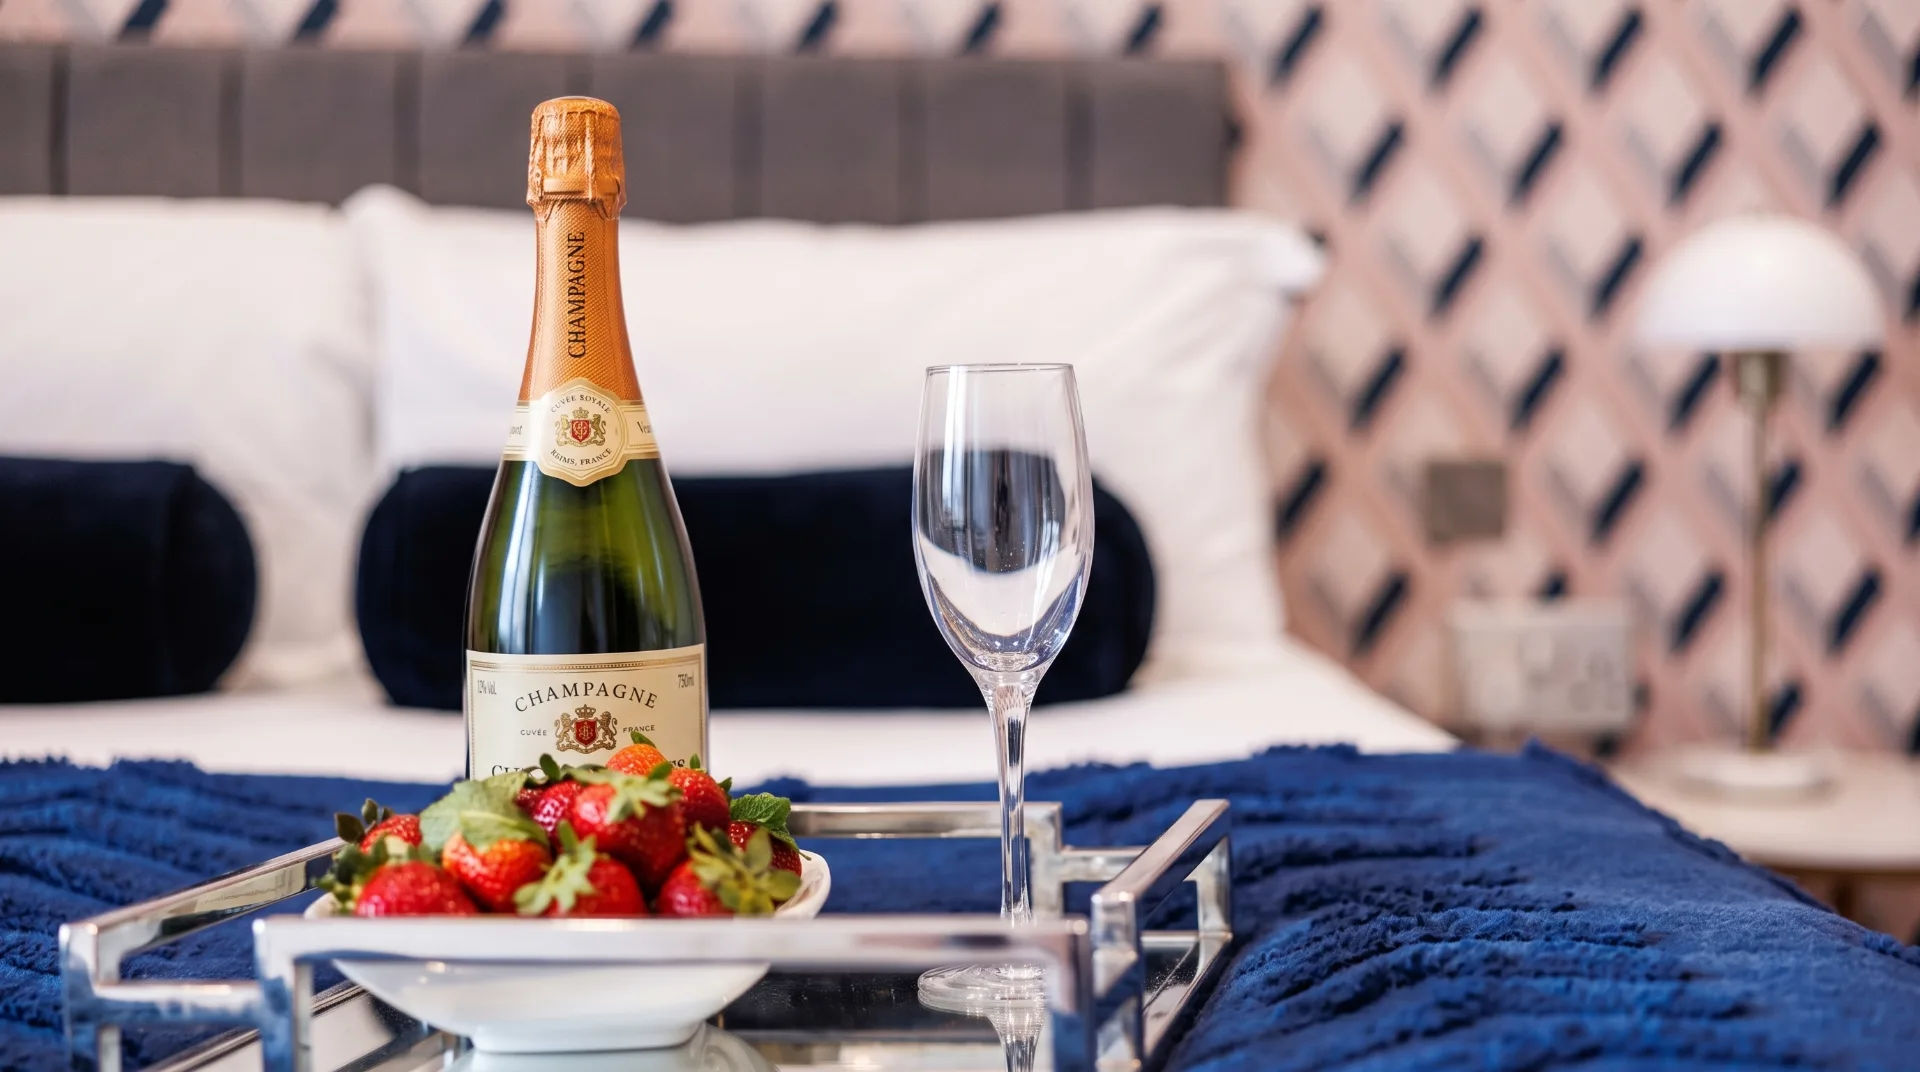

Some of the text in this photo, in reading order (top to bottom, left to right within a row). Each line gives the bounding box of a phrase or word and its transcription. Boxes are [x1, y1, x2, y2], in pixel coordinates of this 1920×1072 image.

[568, 232, 586, 359] CHAMPAGNE
[580, 448, 612, 466] FRANCE
[677, 672, 695, 688] 750ml
[515, 681, 658, 712] CHAMPAGNE
[520, 724, 655, 736] CUVÉE FRANCE
